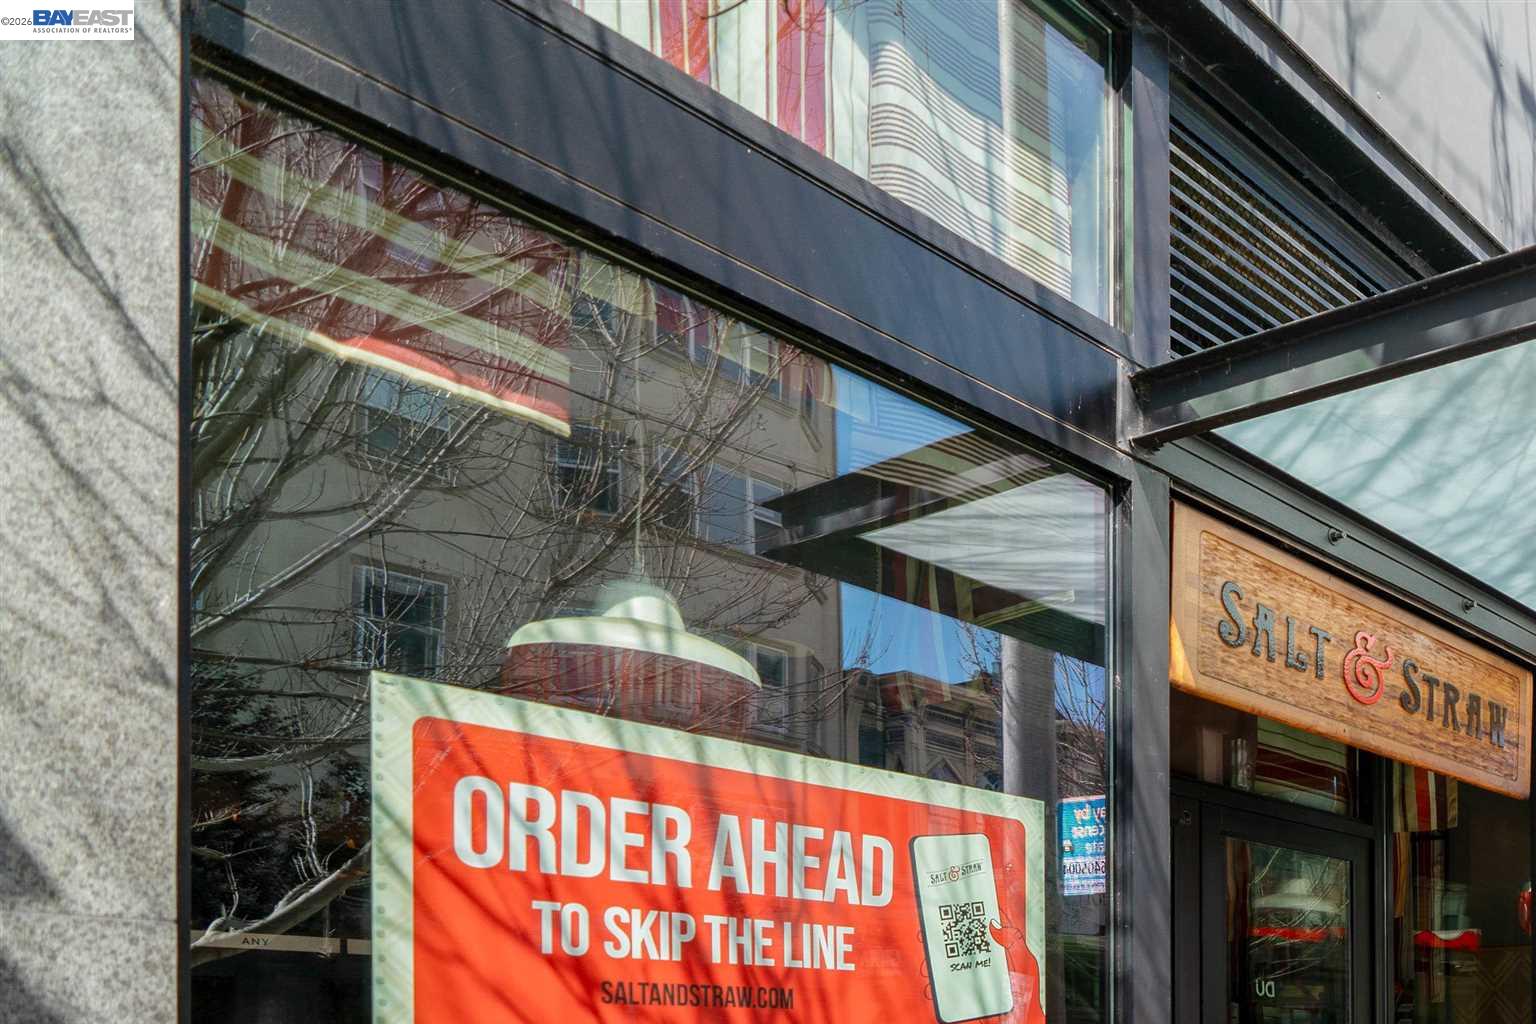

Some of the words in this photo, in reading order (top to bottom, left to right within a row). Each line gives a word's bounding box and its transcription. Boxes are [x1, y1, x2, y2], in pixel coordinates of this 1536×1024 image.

[1219, 580, 1331, 680] SALT
[1342, 631, 1395, 706] &
[1400, 662, 1510, 750] STRAW
[452, 775, 692, 893] ORDER
[708, 814, 894, 908] AHEAD
[930, 871, 949, 885] SALT
[948, 866, 961, 882] &
[961, 862, 982, 877] STRAW
[532, 900, 589, 955] TO
[604, 907, 696, 964] SKIP
[703, 915, 776, 968] THE
[784, 922, 856, 972] LINE
[950, 961, 972, 972] SCAN
[974, 958, 991, 968] ME!
[601, 980, 795, 1011] SALTANDSTRAW.COM
